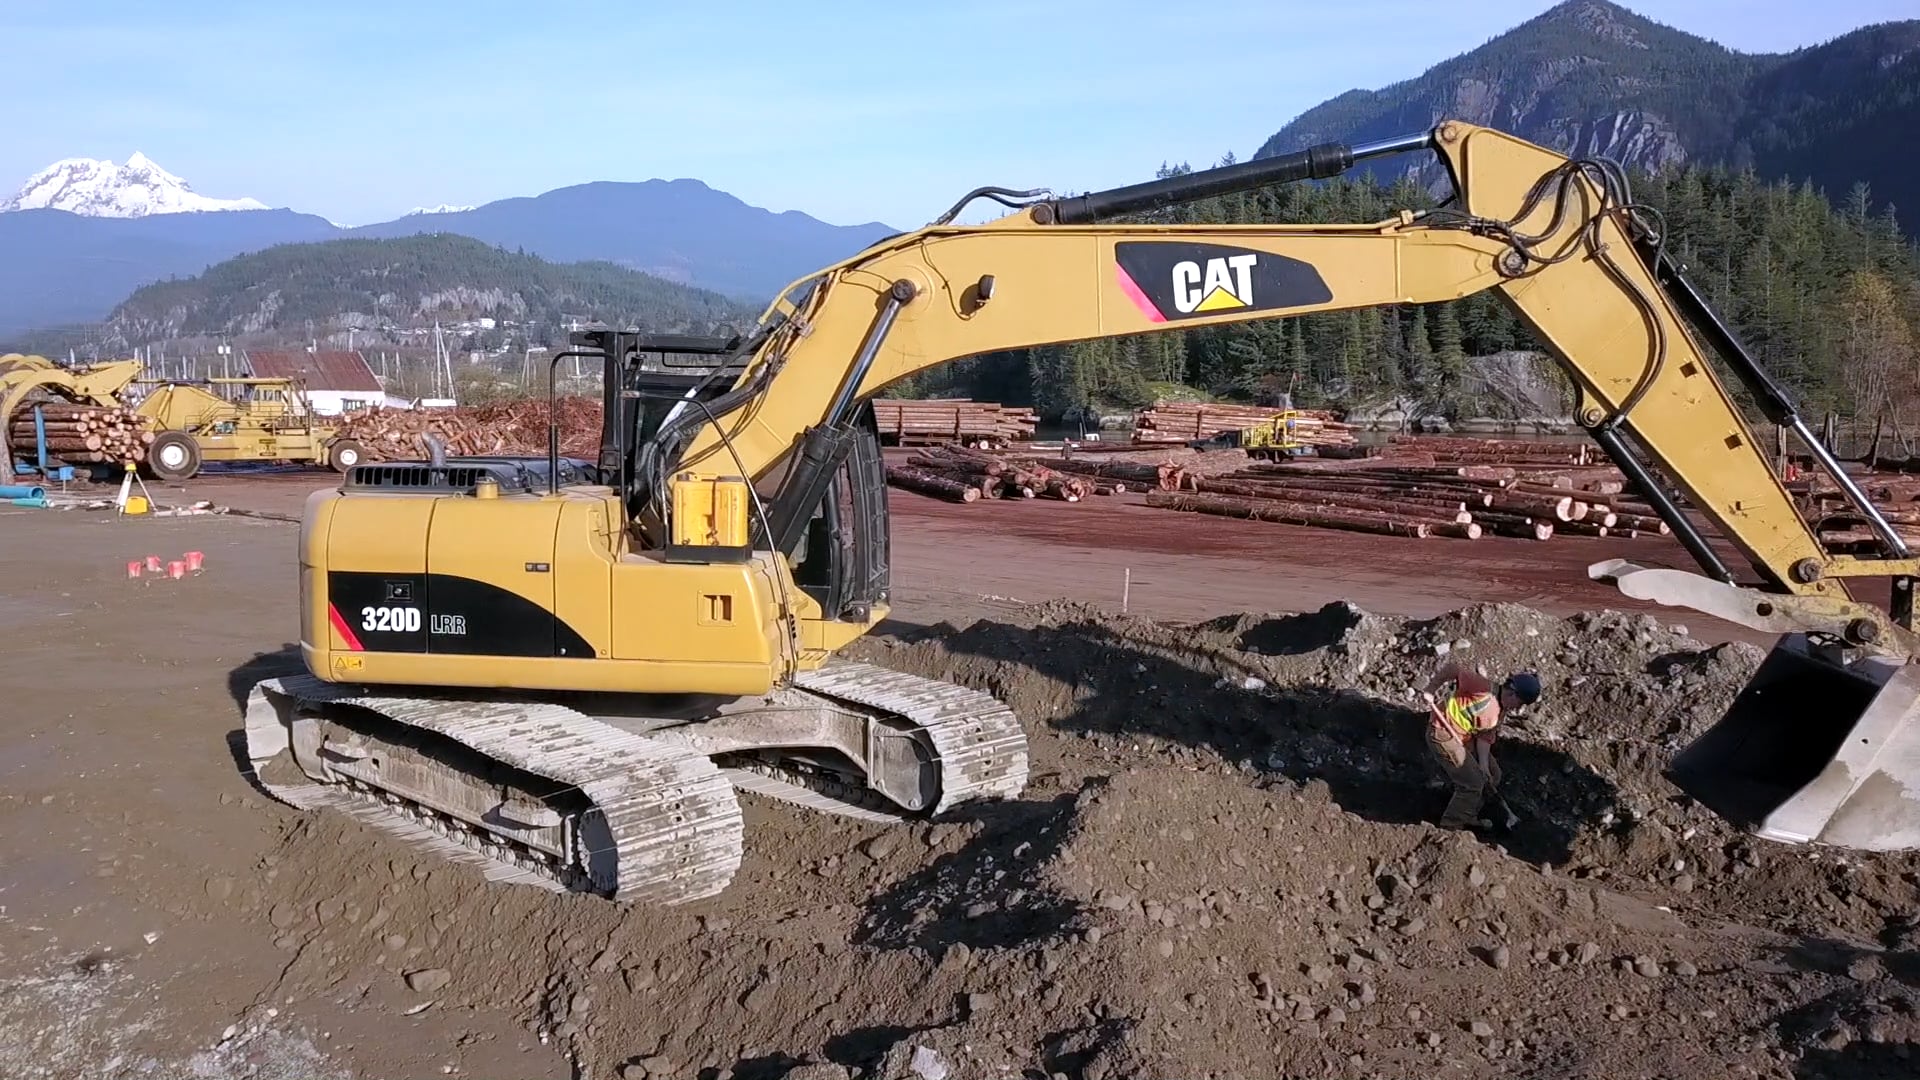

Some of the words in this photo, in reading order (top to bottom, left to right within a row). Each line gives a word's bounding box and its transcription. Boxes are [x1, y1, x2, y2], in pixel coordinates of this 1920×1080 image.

[1172, 254, 1257, 313] CAT
[361, 606, 421, 632] 320D
[430, 614, 467, 635] LRR
